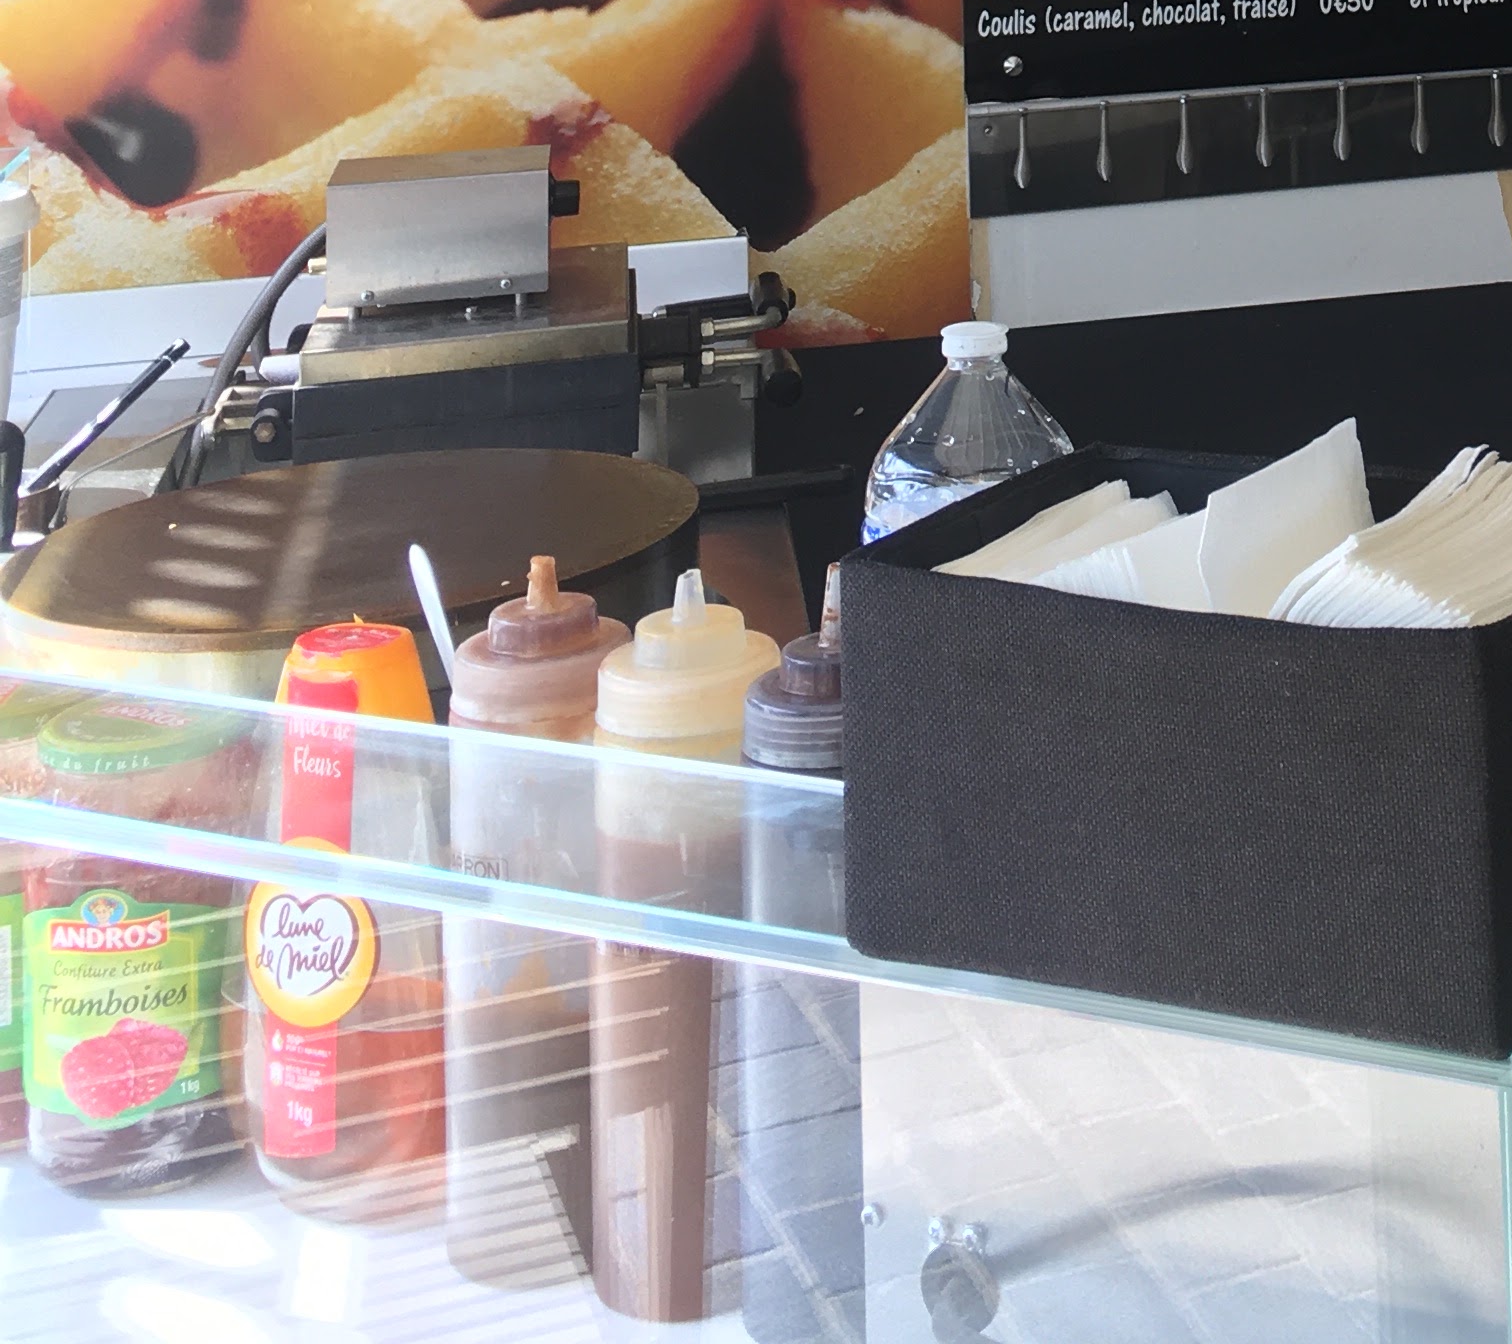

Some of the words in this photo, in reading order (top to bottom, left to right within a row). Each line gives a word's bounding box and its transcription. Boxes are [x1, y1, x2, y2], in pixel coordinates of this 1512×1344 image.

[293, 746, 342, 778] Fleurs
[52, 920, 163, 950] ANDROS
[53, 959, 117, 980] Confiture
[122, 958, 164, 977] Extra
[38, 982, 189, 1018] Framboises
